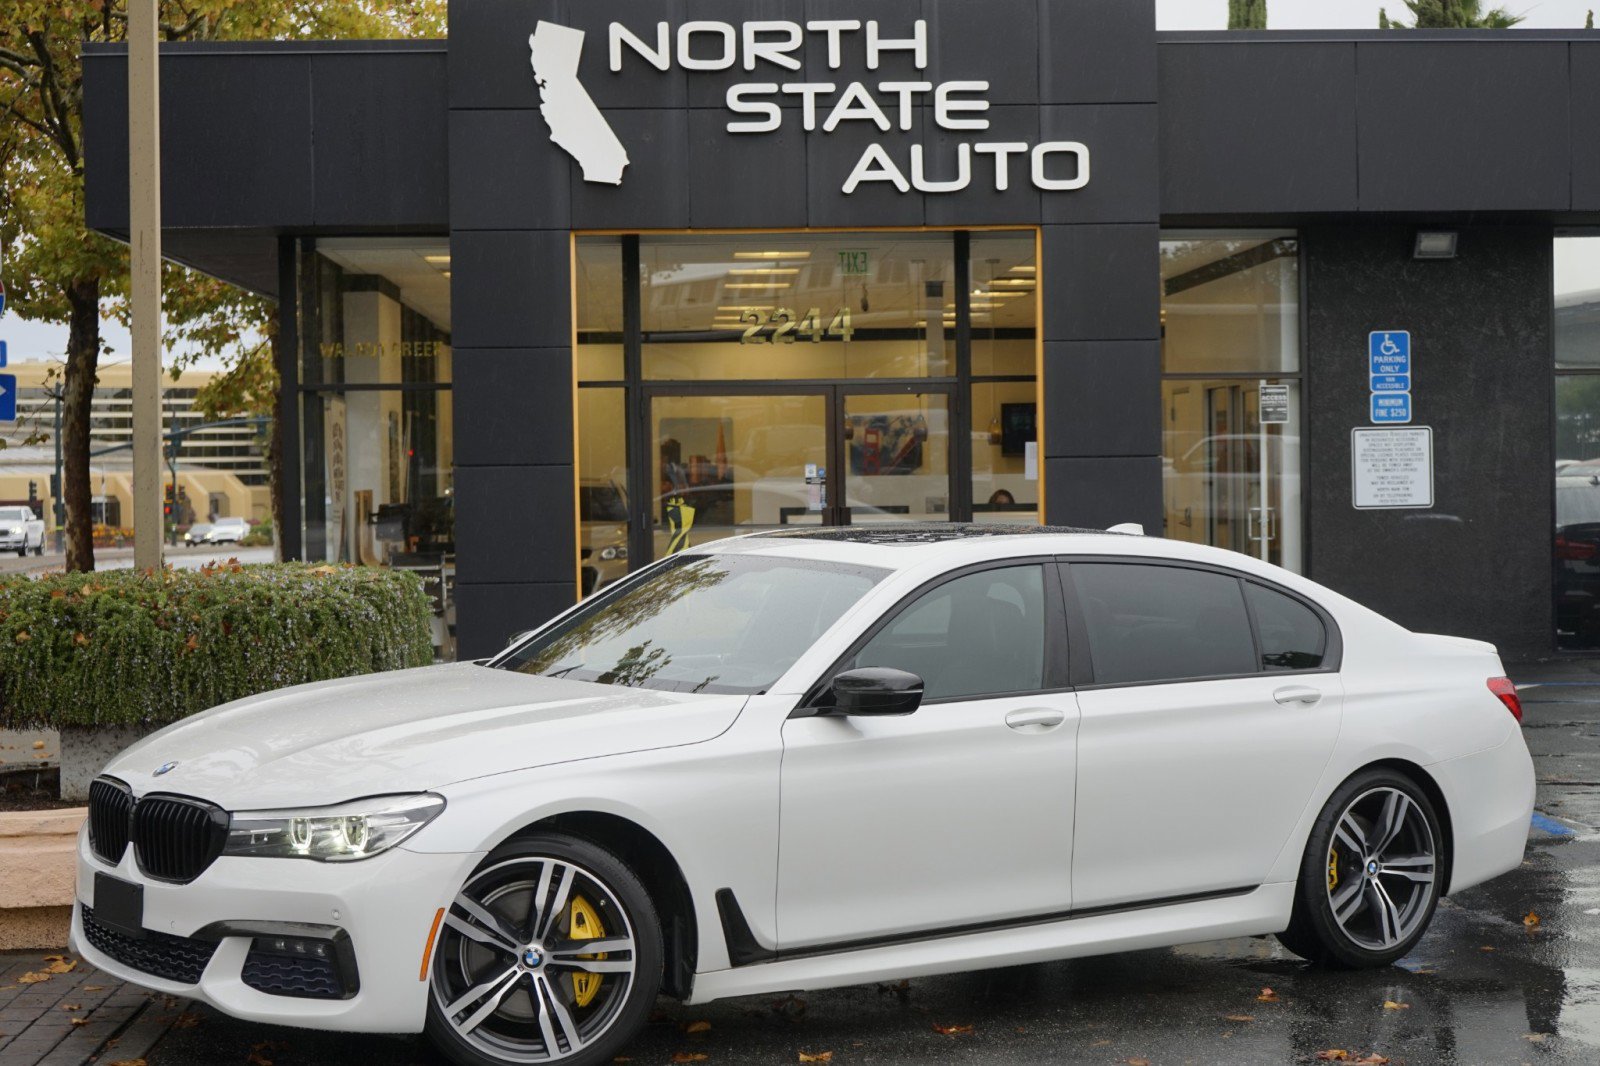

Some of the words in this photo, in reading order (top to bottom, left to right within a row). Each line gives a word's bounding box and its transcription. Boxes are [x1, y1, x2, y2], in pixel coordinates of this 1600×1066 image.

[609, 19, 927, 72] NORTH
[726, 80, 990, 133] STATE
[841, 141, 1090, 194] AUTO
[740, 305, 854, 344] 2244
[1374, 355, 1406, 364] PARKING
[1380, 365, 1400, 373] ONLY
[1375, 408, 1388, 417] FINE
[1390, 408, 1407, 417] $250
